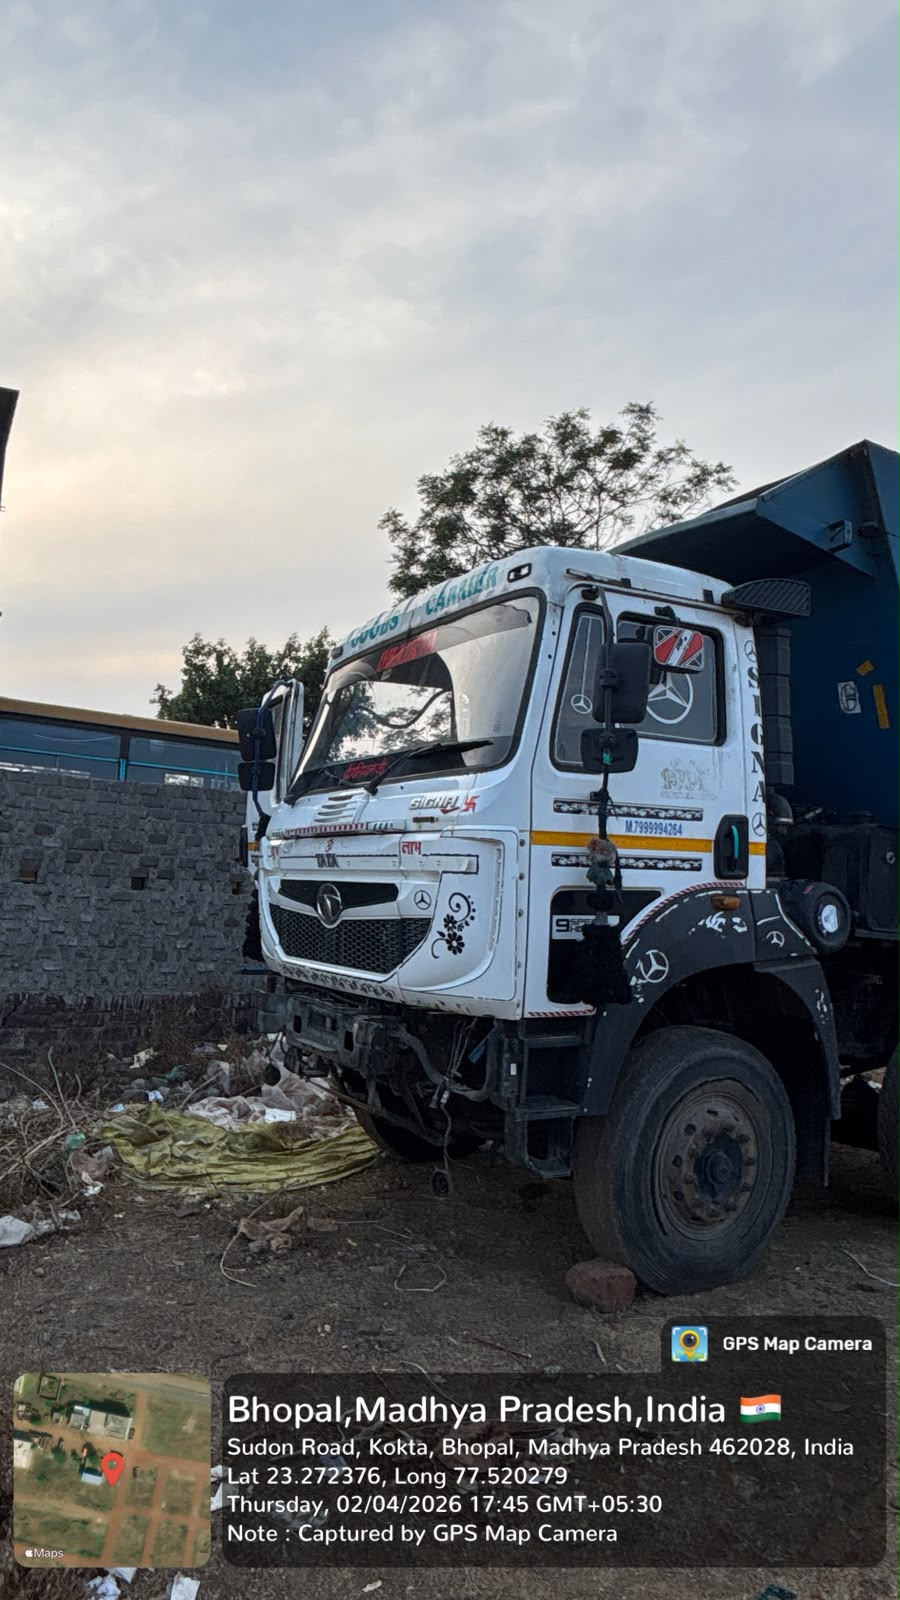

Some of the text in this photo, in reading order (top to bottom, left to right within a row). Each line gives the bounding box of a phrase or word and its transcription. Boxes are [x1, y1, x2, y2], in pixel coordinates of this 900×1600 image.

[425, 565, 500, 615] CARRIER
[400, 841, 422, 855] लाभ
[315, 853, 340, 868] TATA
[556, 919, 570, 932] 9
